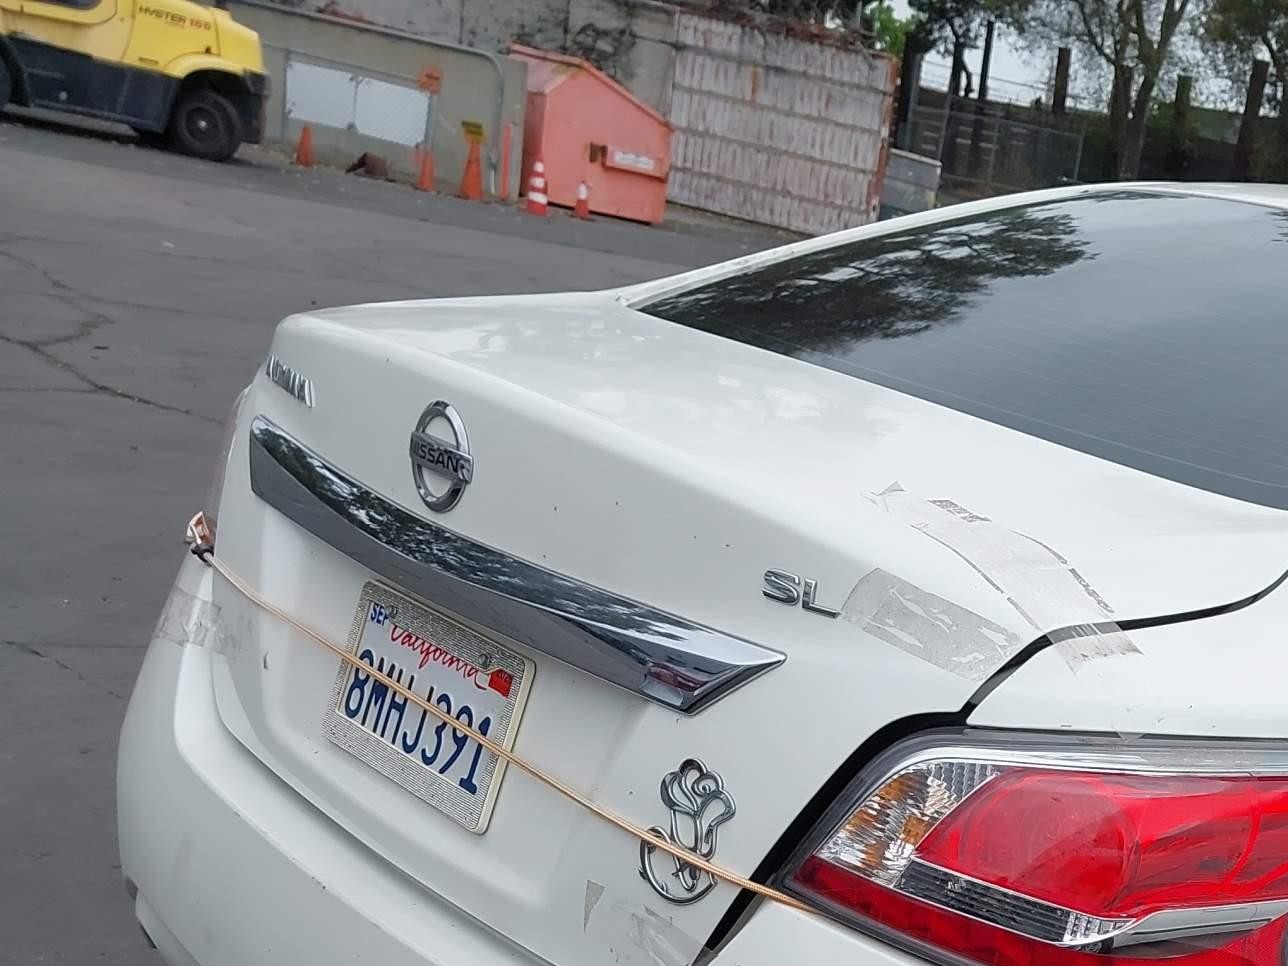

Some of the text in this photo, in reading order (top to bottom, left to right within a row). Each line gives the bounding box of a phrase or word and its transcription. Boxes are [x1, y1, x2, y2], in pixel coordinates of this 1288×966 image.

[138, 5, 186, 25] HYSTER
[761, 568, 841, 619] SL
[344, 648, 491, 795] 8MHJ391
